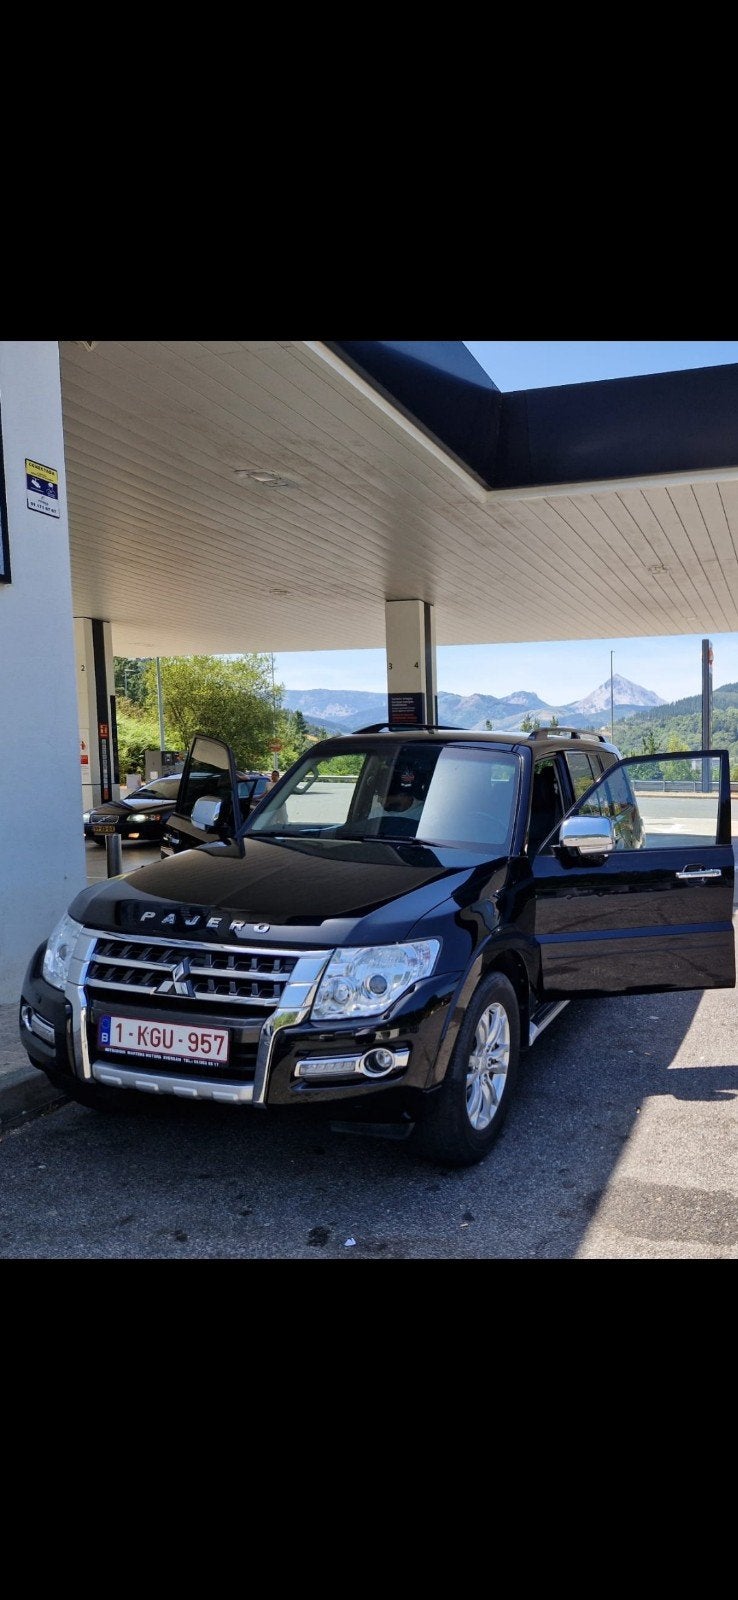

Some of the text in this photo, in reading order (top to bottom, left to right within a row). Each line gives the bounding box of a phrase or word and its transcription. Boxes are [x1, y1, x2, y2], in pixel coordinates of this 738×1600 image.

[388, 662, 393, 670] 3
[140, 911, 271, 933] PAJERO
[101, 1032, 109, 1043] B
